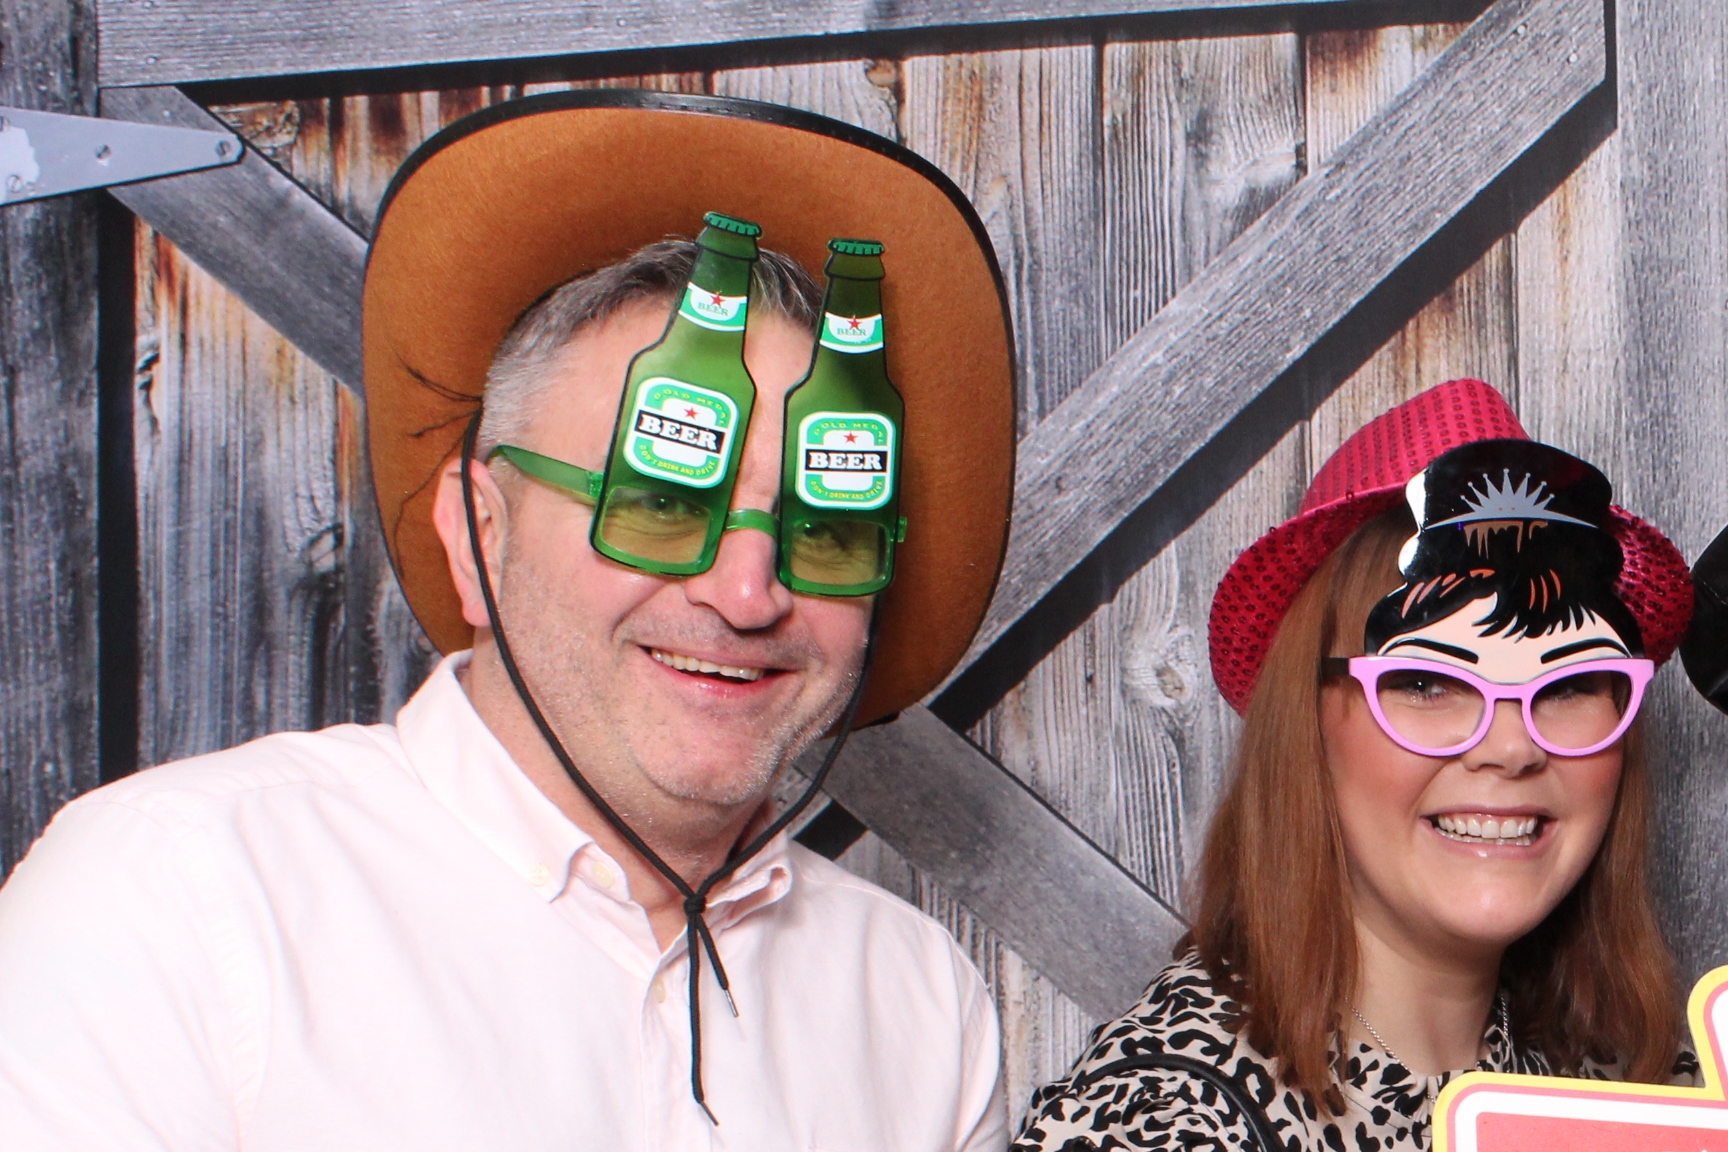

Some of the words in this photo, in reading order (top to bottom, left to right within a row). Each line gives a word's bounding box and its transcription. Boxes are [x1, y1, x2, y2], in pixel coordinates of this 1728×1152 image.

[698, 302, 729, 317] BEER
[837, 327, 867, 336] BEER
[639, 413, 718, 451] BEER
[657, 461, 680, 471] DRINK
[680, 466, 695, 475] AND
[696, 460, 715, 475] DRIVE
[808, 451, 882, 470] BEER
[829, 491, 850, 499] DRINK
[866, 481, 882, 498] DRIVE
